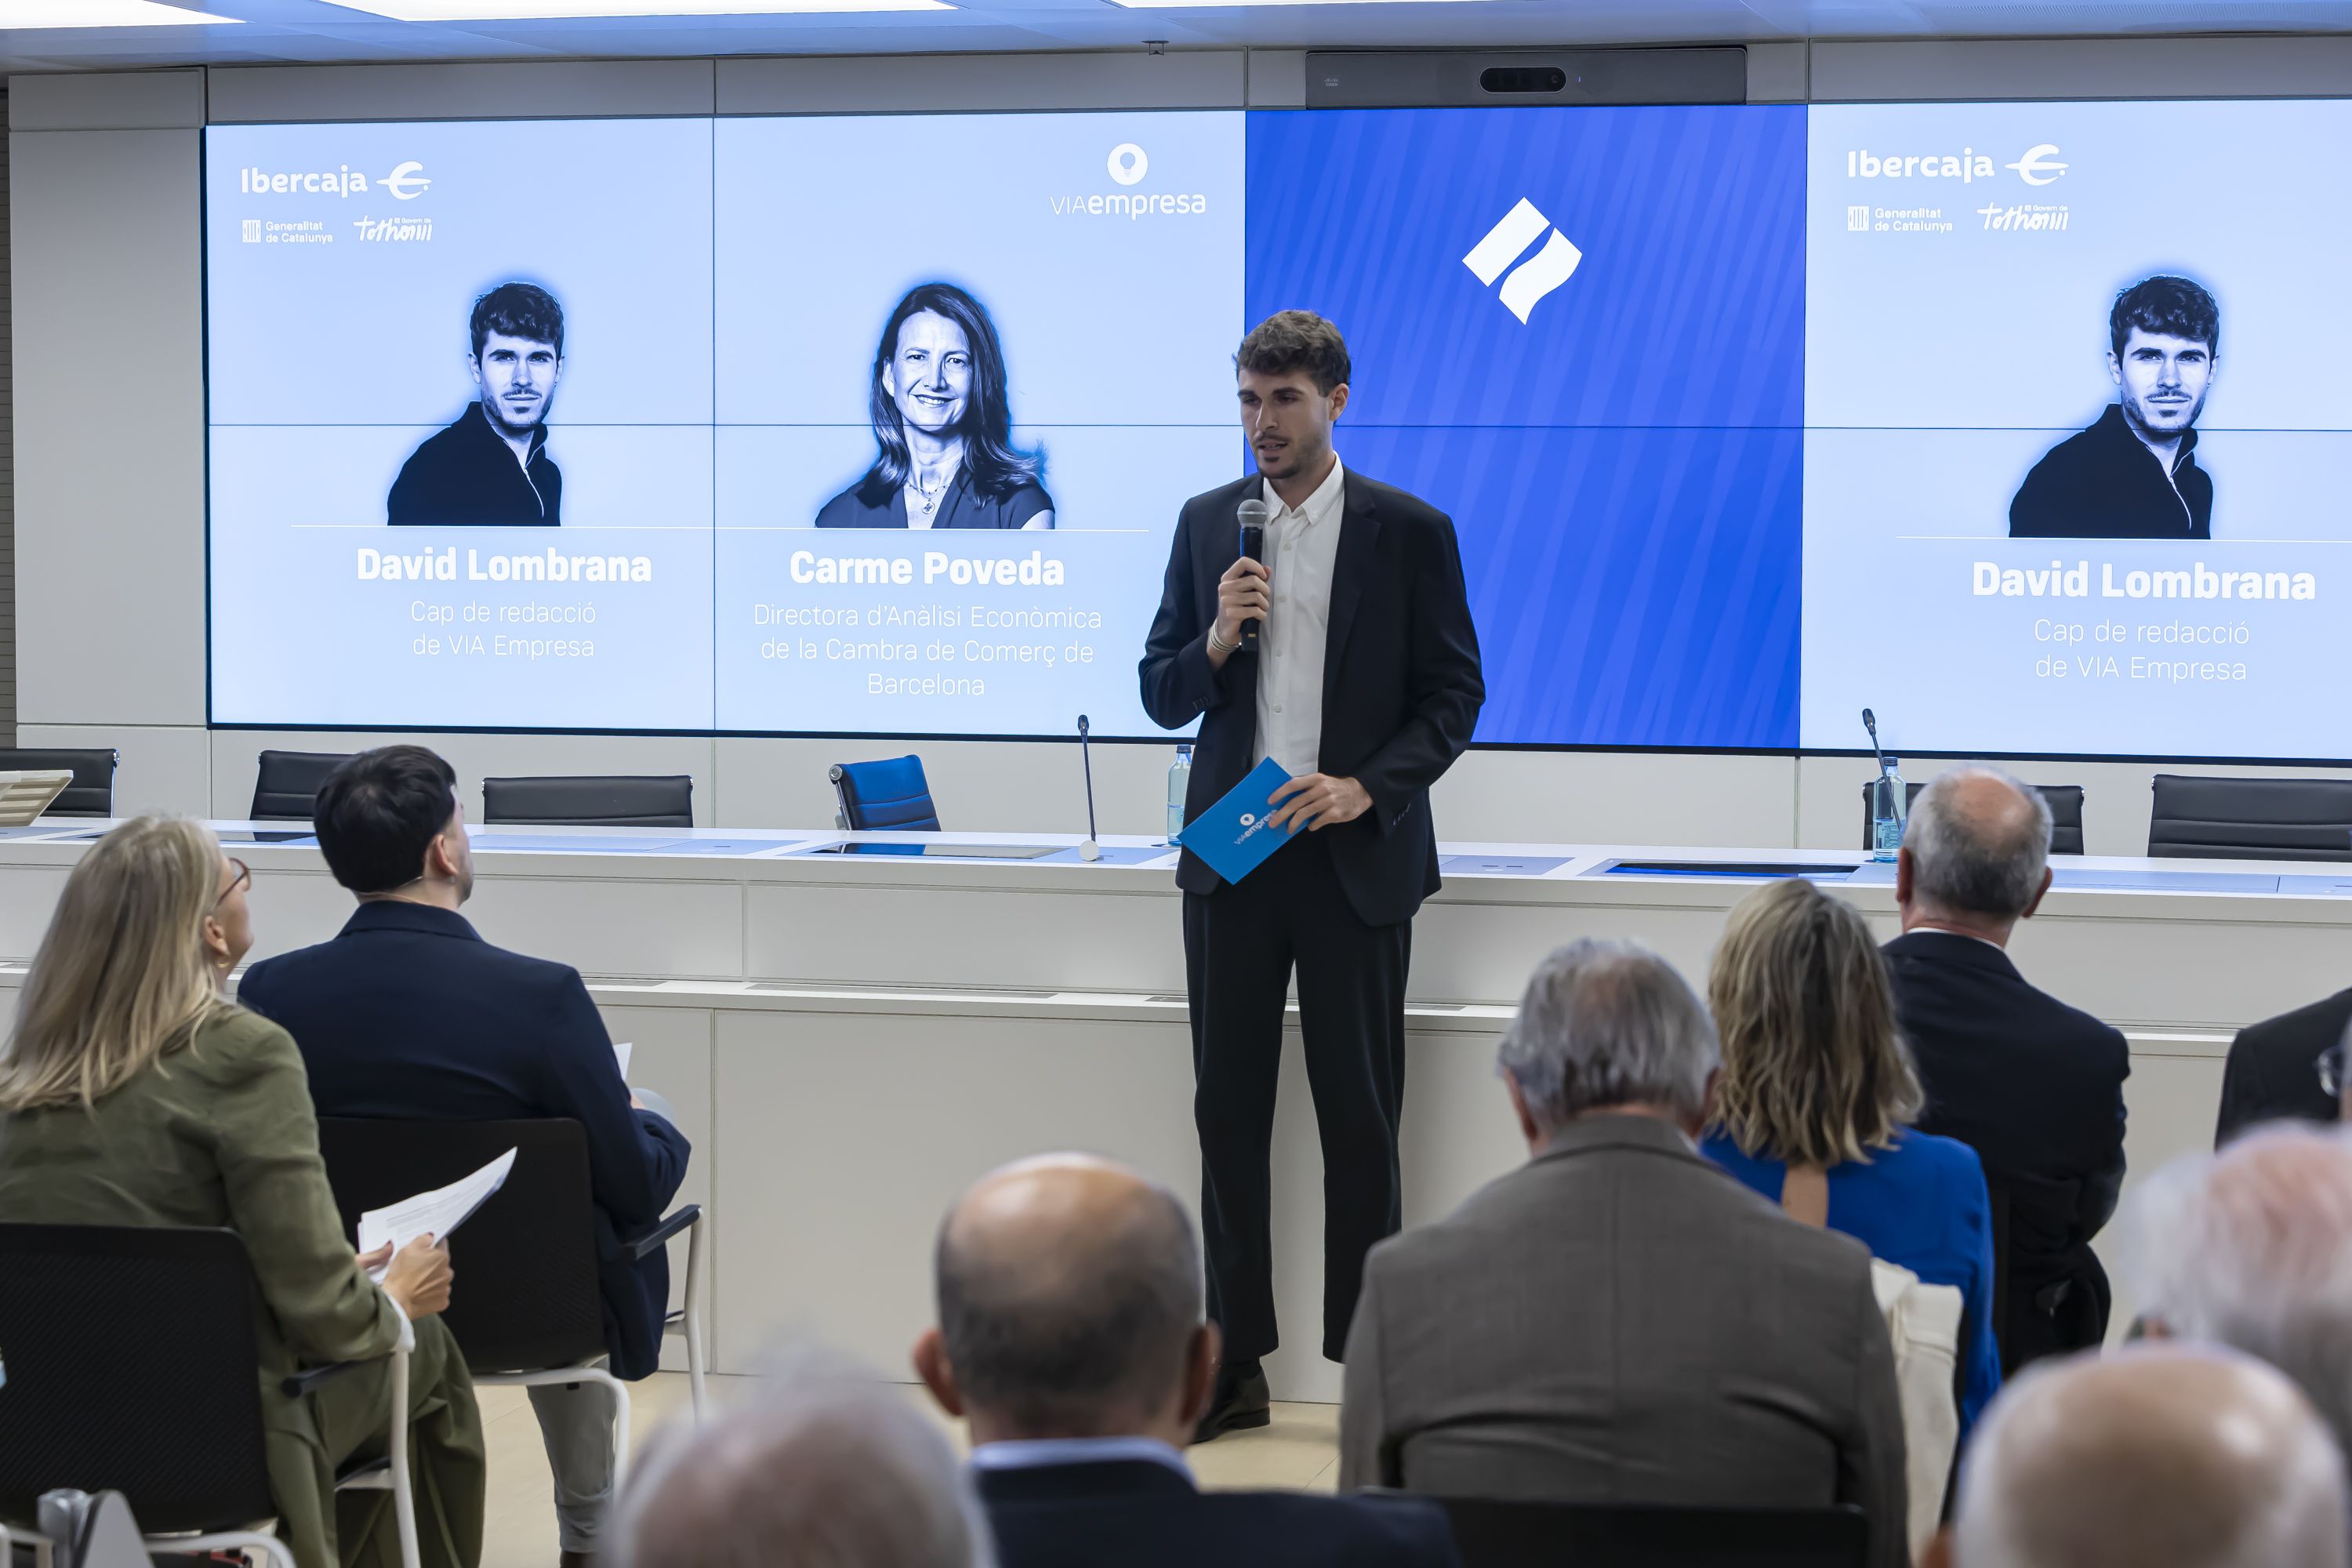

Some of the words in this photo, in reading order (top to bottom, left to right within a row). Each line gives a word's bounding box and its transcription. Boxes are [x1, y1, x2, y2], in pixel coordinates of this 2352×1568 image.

[1848, 147, 1995, 184] Ibercaja
[241, 164, 368, 198] Ibercaja
[265, 220, 323, 231] Generalitat
[1874, 220, 1889, 231] de
[1893, 220, 1953, 234] Catalunya
[1875, 207, 1941, 219] Generalitat
[265, 233, 278, 243] de
[281, 232, 333, 245] Catalunya
[357, 546, 457, 581] David
[468, 546, 652, 583] Lombrana
[789, 550, 913, 585] Carme
[924, 550, 1065, 586] Poveda
[1973, 560, 2089, 597] David
[2101, 561, 2316, 601] Lombrana
[411, 601, 454, 626] Cap
[463, 601, 491, 622] de
[499, 601, 596, 623] redacció
[754, 603, 858, 626] Directora
[971, 605, 1102, 629] Econòmica
[413, 633, 441, 655] de
[448, 634, 485, 655] VIA
[495, 635, 594, 661] Empresa
[2034, 619, 2085, 647] Cap
[2095, 619, 2126, 643] de
[2137, 619, 2249, 644] redacció
[761, 637, 789, 659] de
[799, 637, 817, 659] la
[826, 637, 917, 661] Cambra
[926, 639, 955, 662] de
[964, 640, 1056, 668] Comerç
[1065, 640, 1094, 663] de
[2035, 653, 2067, 678] de
[2077, 655, 2120, 678] VIA
[2131, 656, 2246, 684] Empresa
[868, 672, 985, 696] Barcelona
